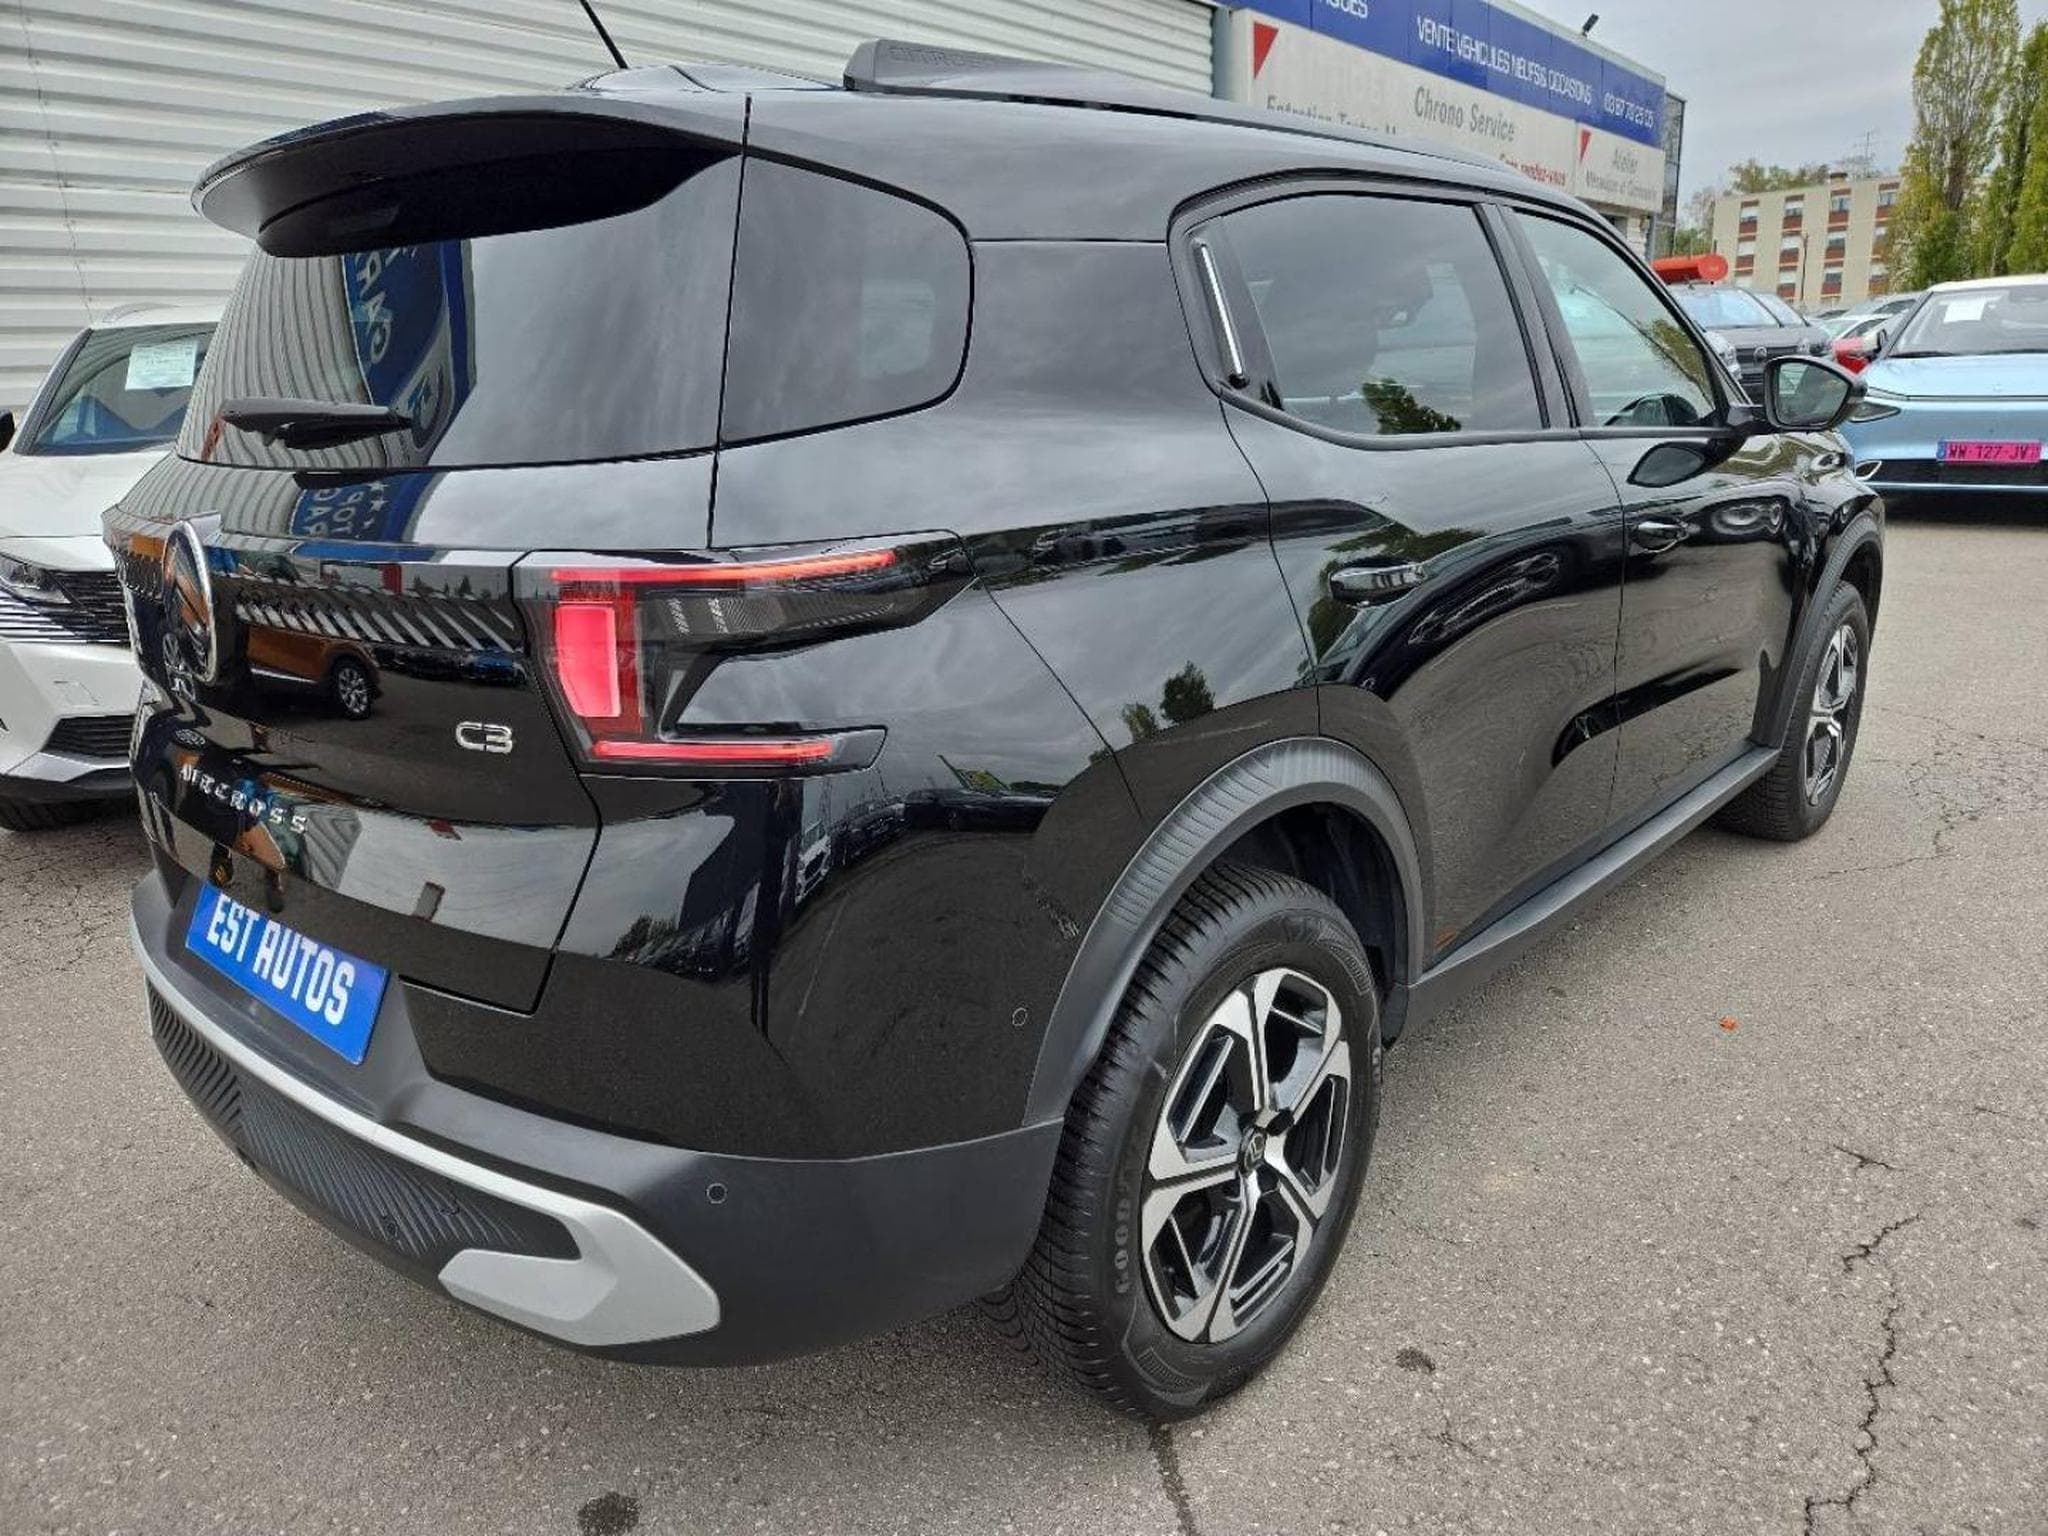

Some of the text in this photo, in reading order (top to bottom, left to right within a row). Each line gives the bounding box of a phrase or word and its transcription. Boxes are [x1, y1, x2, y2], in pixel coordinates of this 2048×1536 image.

[1417, 14, 1455, 54] VENTE
[1415, 85, 1463, 129] Chrono
[1470, 103, 1515, 142] Service
[455, 719, 514, 756] C3
[206, 892, 356, 1026] EST AUTOS
